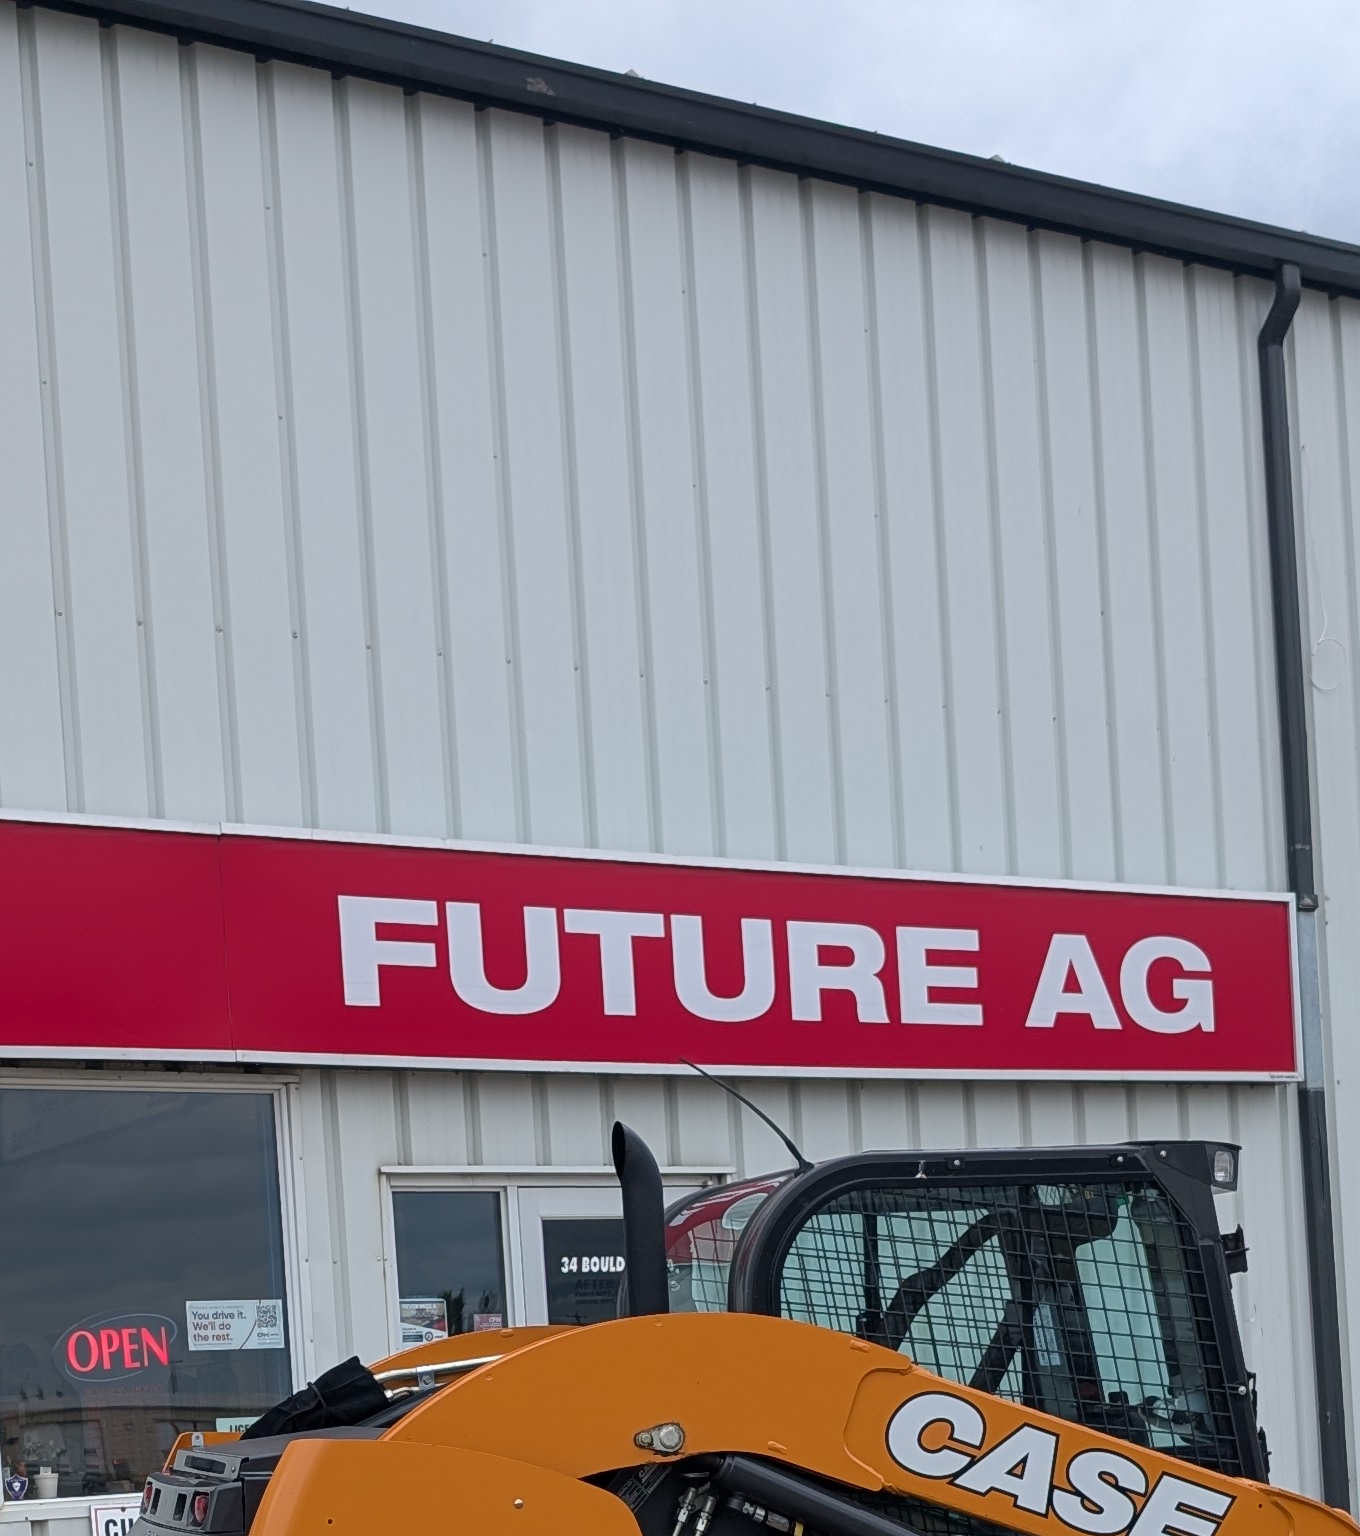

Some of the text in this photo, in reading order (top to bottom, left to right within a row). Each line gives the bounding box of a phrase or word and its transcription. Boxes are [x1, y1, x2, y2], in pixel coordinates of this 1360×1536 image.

[337, 894, 1215, 1033] FUTURE AG
[561, 1256, 578, 1273] 34
[191, 1310, 246, 1320] You drive it.
[192, 1322, 231, 1331] We'll do
[193, 1332, 233, 1342] the rest.
[66, 1326, 169, 1372] OPEN
